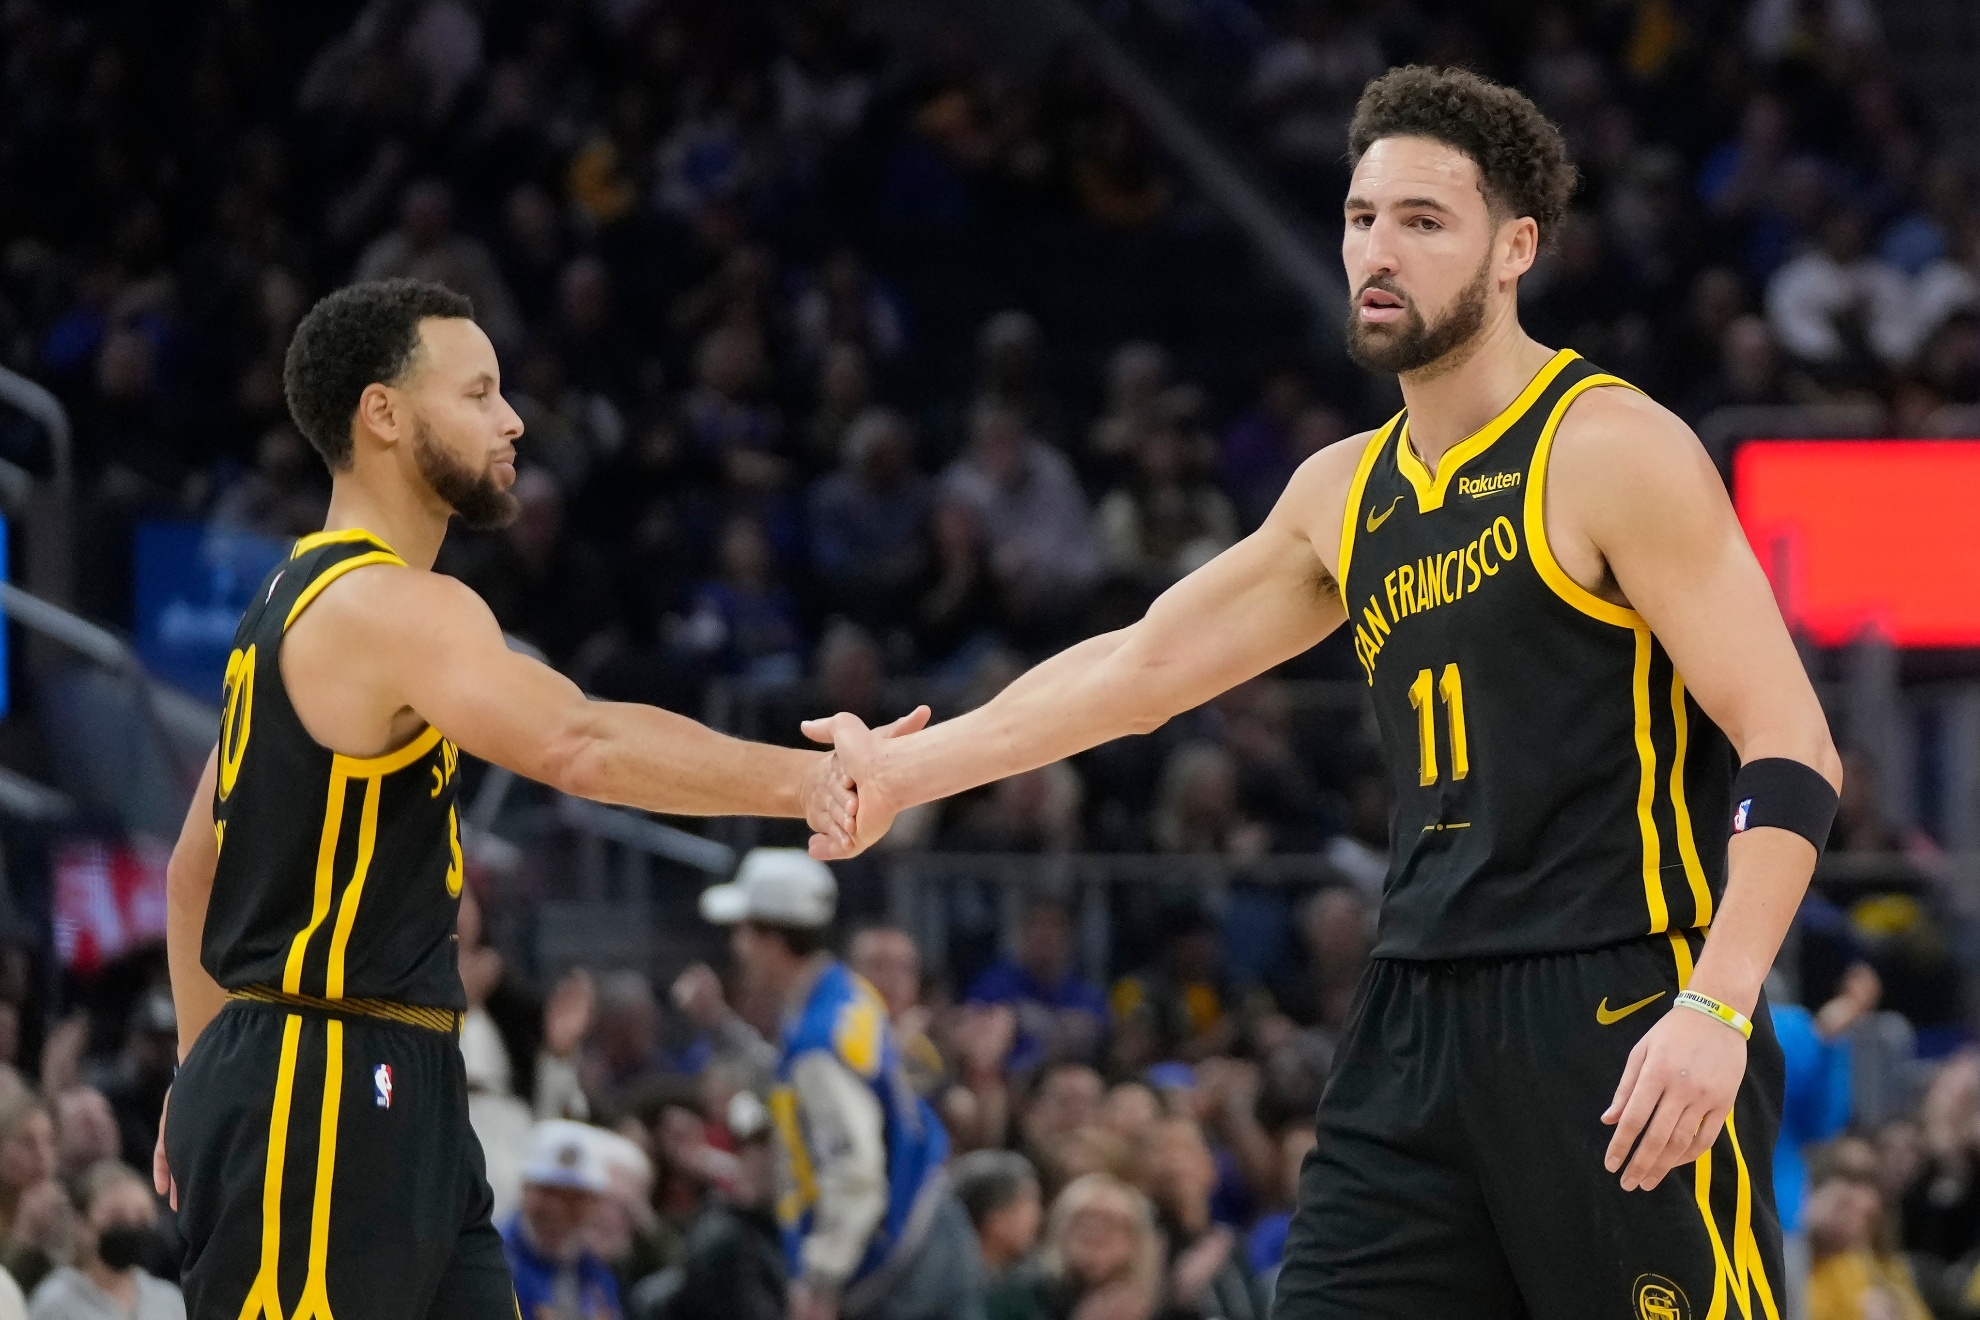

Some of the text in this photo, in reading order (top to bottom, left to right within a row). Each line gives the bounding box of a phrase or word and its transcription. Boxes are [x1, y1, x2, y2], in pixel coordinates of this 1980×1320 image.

[1458, 471, 1521, 496] Rakuten
[1354, 515, 1518, 686] SAN FRANCISCO
[1408, 662, 1469, 787] 11
